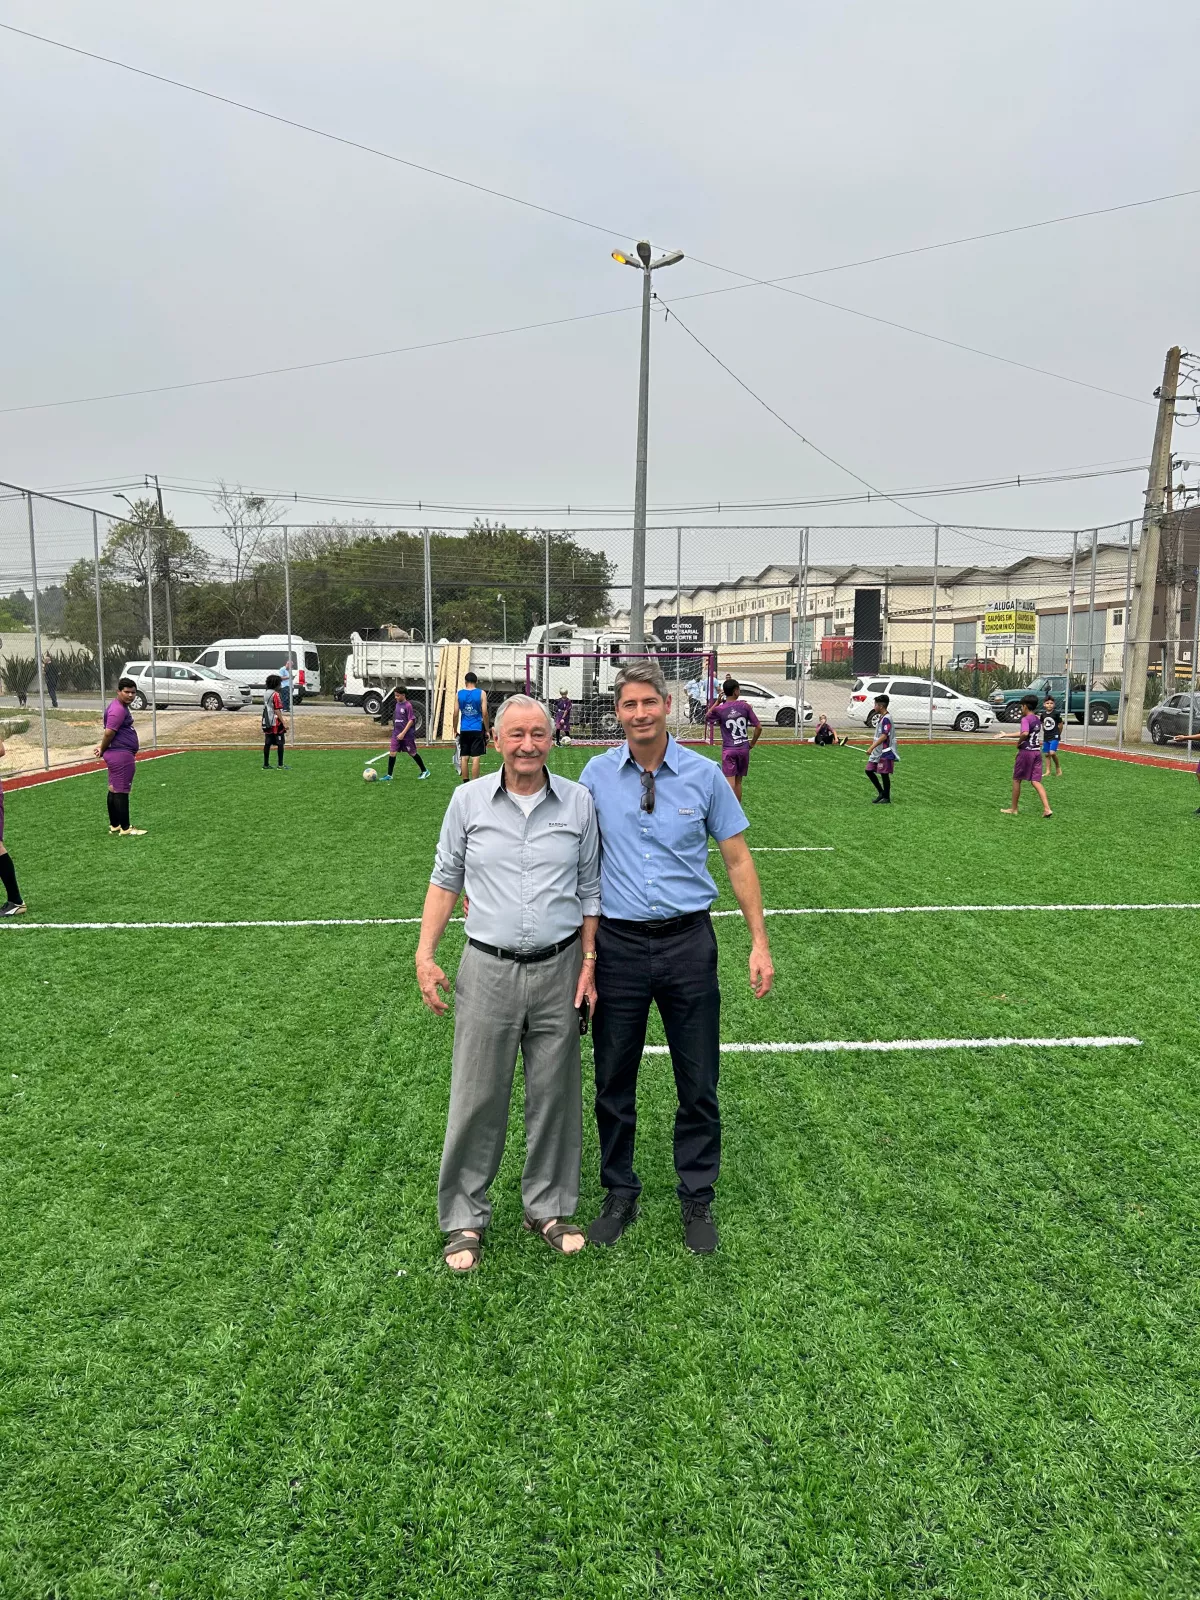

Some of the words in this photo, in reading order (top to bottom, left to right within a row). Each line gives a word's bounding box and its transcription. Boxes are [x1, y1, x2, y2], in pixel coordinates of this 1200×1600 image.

[994, 601, 1014, 610] ALUGA
[1022, 602, 1036, 611] ALUGA
[726, 716, 748, 740] 28
